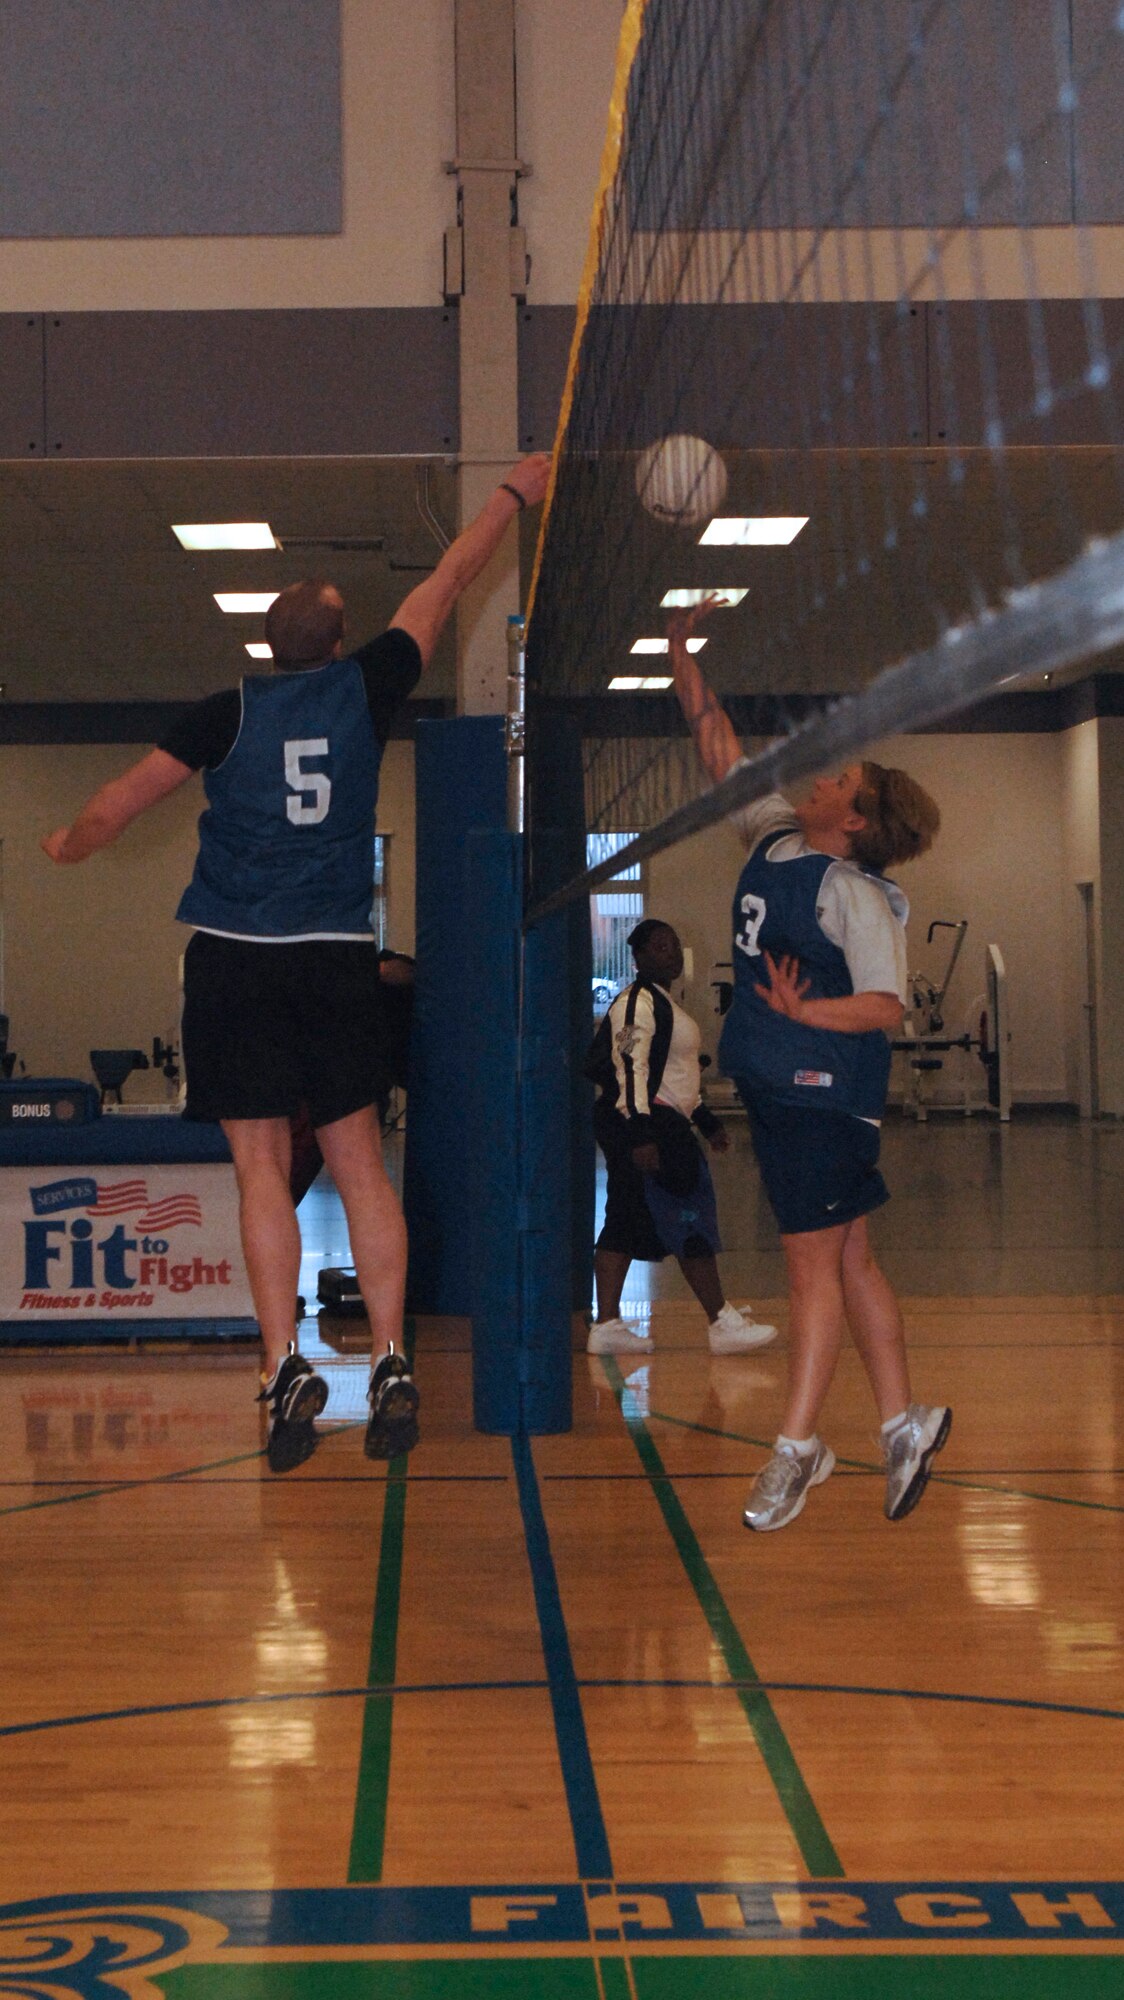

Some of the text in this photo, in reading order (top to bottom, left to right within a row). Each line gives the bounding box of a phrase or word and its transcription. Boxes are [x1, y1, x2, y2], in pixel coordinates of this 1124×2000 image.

[284, 738, 331, 825] 5
[736, 894, 766, 957] 3
[12, 1104, 50, 1117] BONUS
[37, 1185, 93, 1206] SERVICES
[22, 1219, 169, 1289] Fit to
[20, 1291, 154, 1310] Fitness & Sports
[470, 1892, 1116, 1932] FAIRCH
